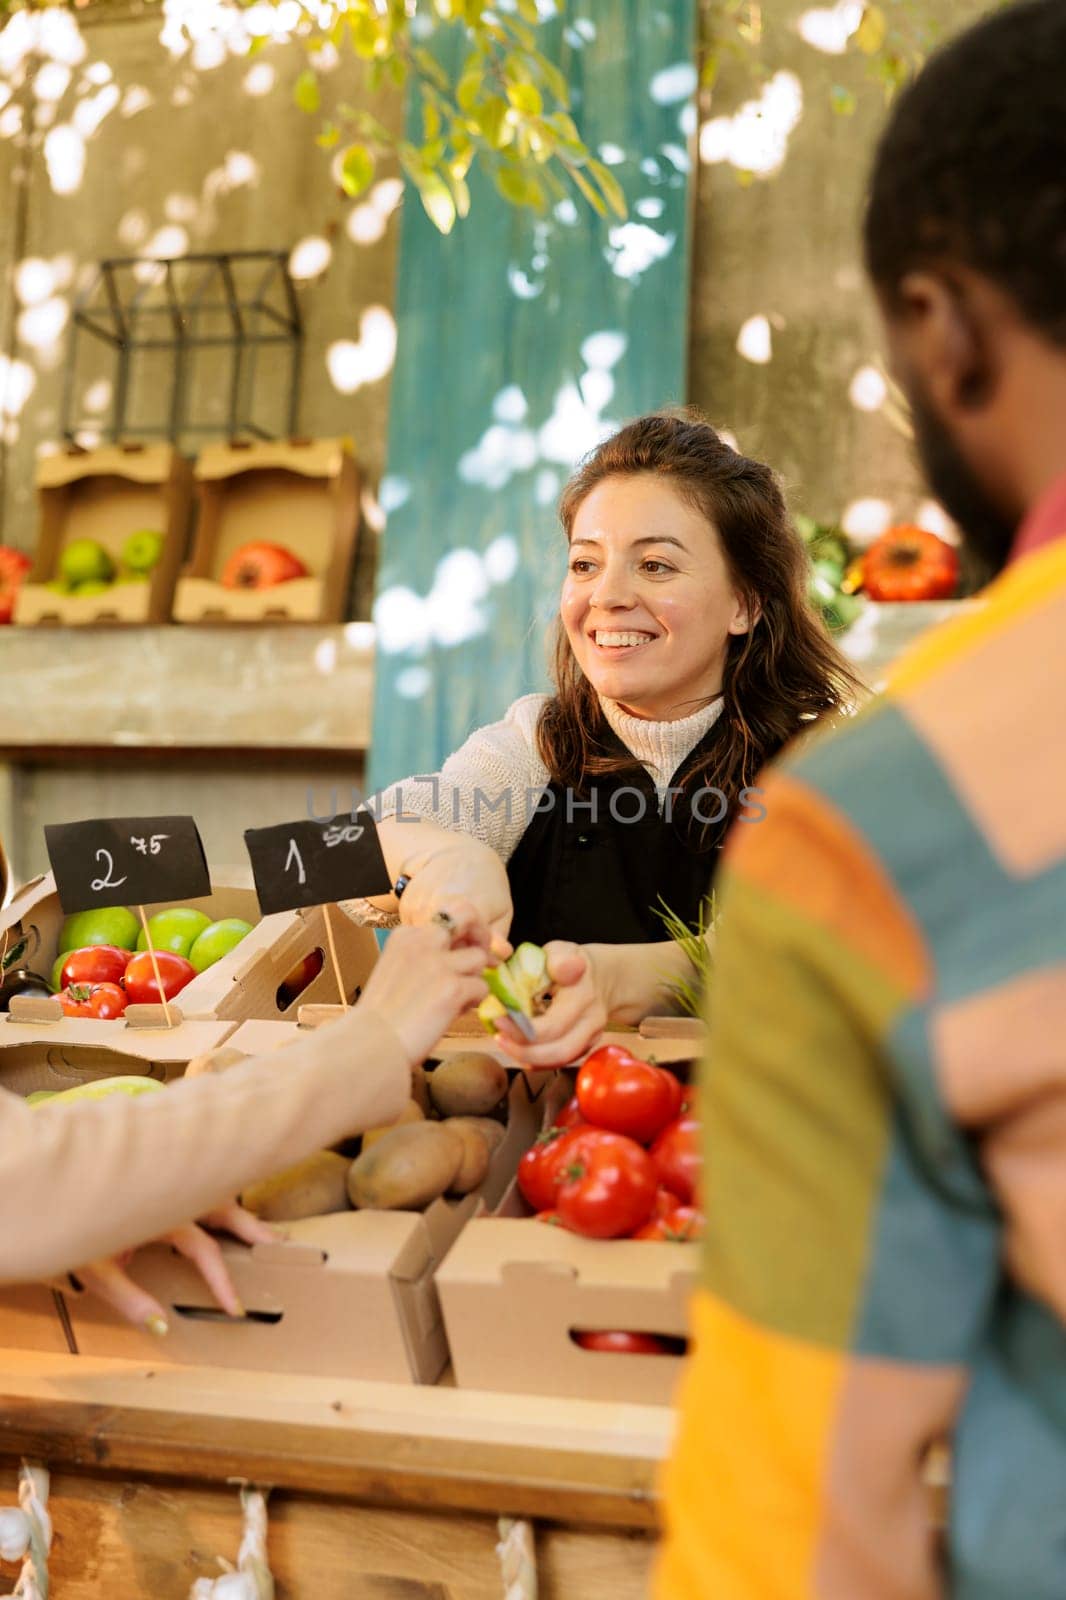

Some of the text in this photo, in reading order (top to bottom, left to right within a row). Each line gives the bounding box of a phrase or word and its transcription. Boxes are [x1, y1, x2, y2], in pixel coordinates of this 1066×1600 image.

[91, 834, 171, 891] 2 75
[284, 825, 365, 884] 1 50
